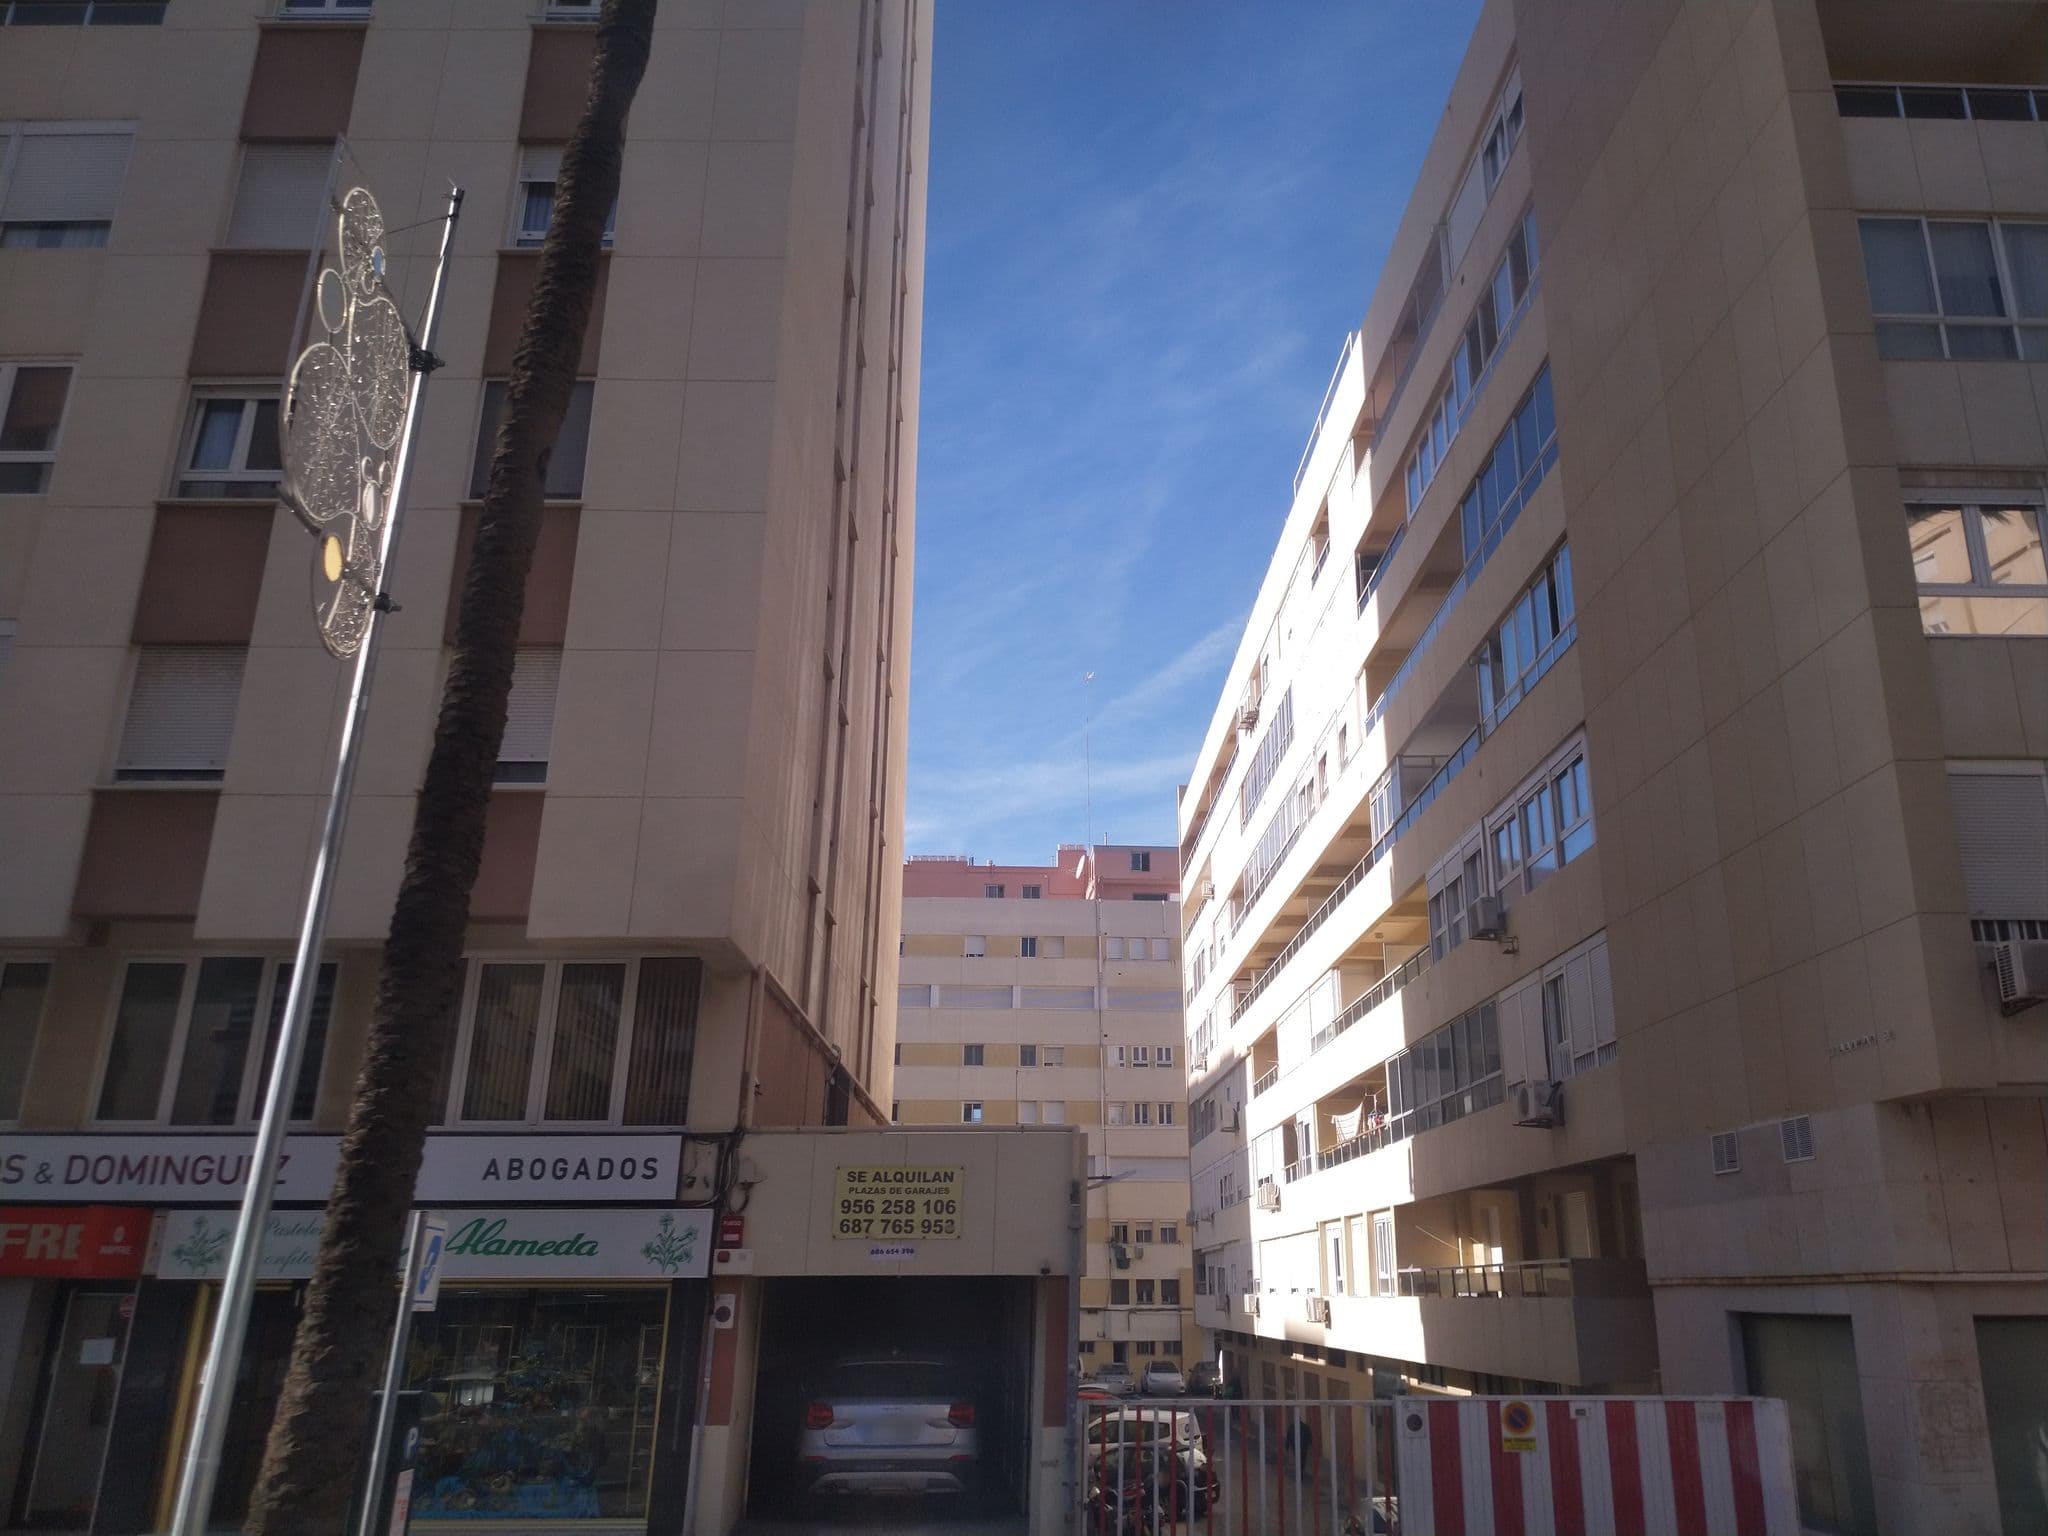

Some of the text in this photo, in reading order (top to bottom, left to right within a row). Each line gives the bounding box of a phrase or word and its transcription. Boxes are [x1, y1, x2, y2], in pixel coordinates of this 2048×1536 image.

[0, 1154, 28, 1185] S
[33, 1162, 54, 1185] &
[482, 1157, 659, 1181] ABOGADOS
[847, 1171, 954, 1183] SE ALQUILAN
[848, 1187, 951, 1195] PLAZAS DE GARAJES
[840, 1199, 956, 1214] 956 258 106
[839, 1219, 874, 1234] 687
[880, 1219, 914, 1234] 765
[445, 1217, 599, 1257] Alameda
